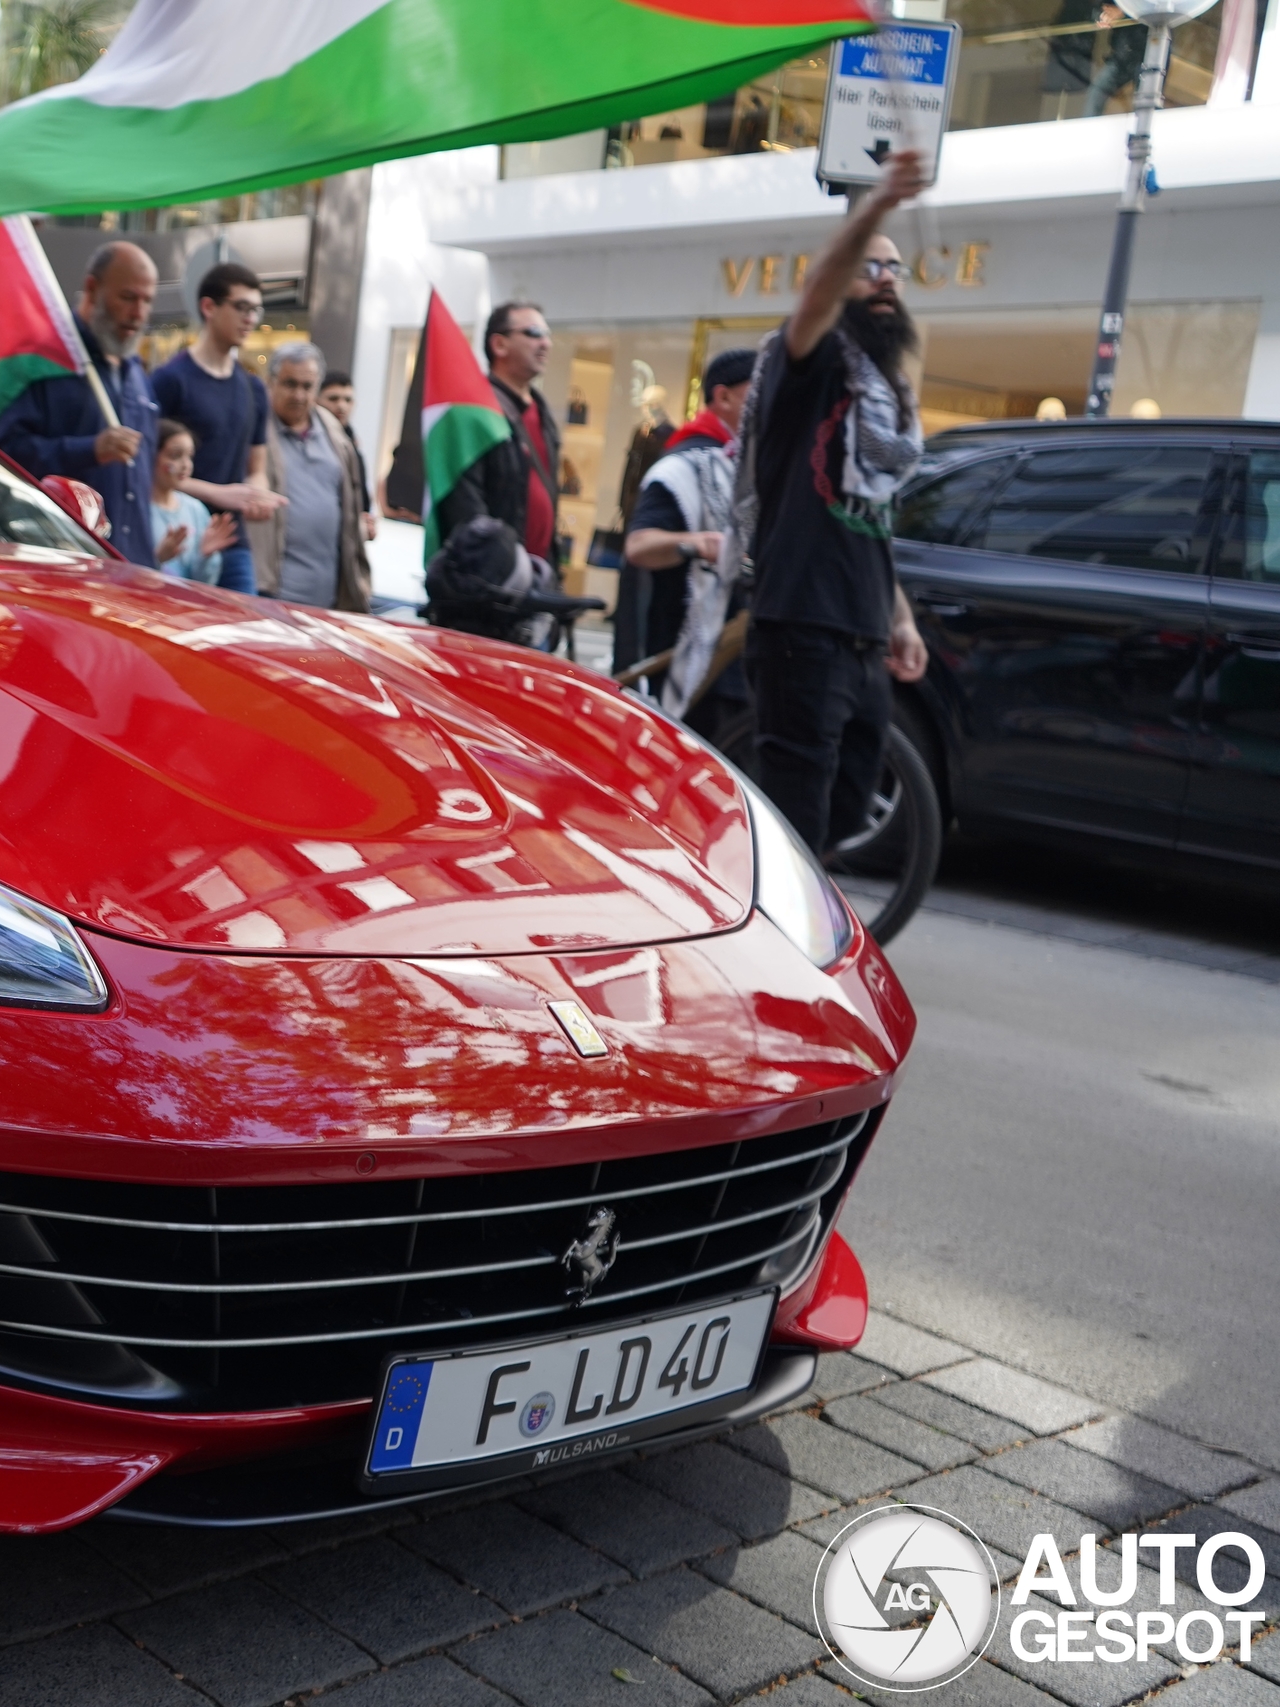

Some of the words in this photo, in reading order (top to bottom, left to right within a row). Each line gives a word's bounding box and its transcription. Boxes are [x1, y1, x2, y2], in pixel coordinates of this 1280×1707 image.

[860, 51, 926, 78] AUTOMAT
[837, 84, 863, 105] Hier
[476, 1361, 531, 1445] F
[385, 1427, 404, 1451] D
